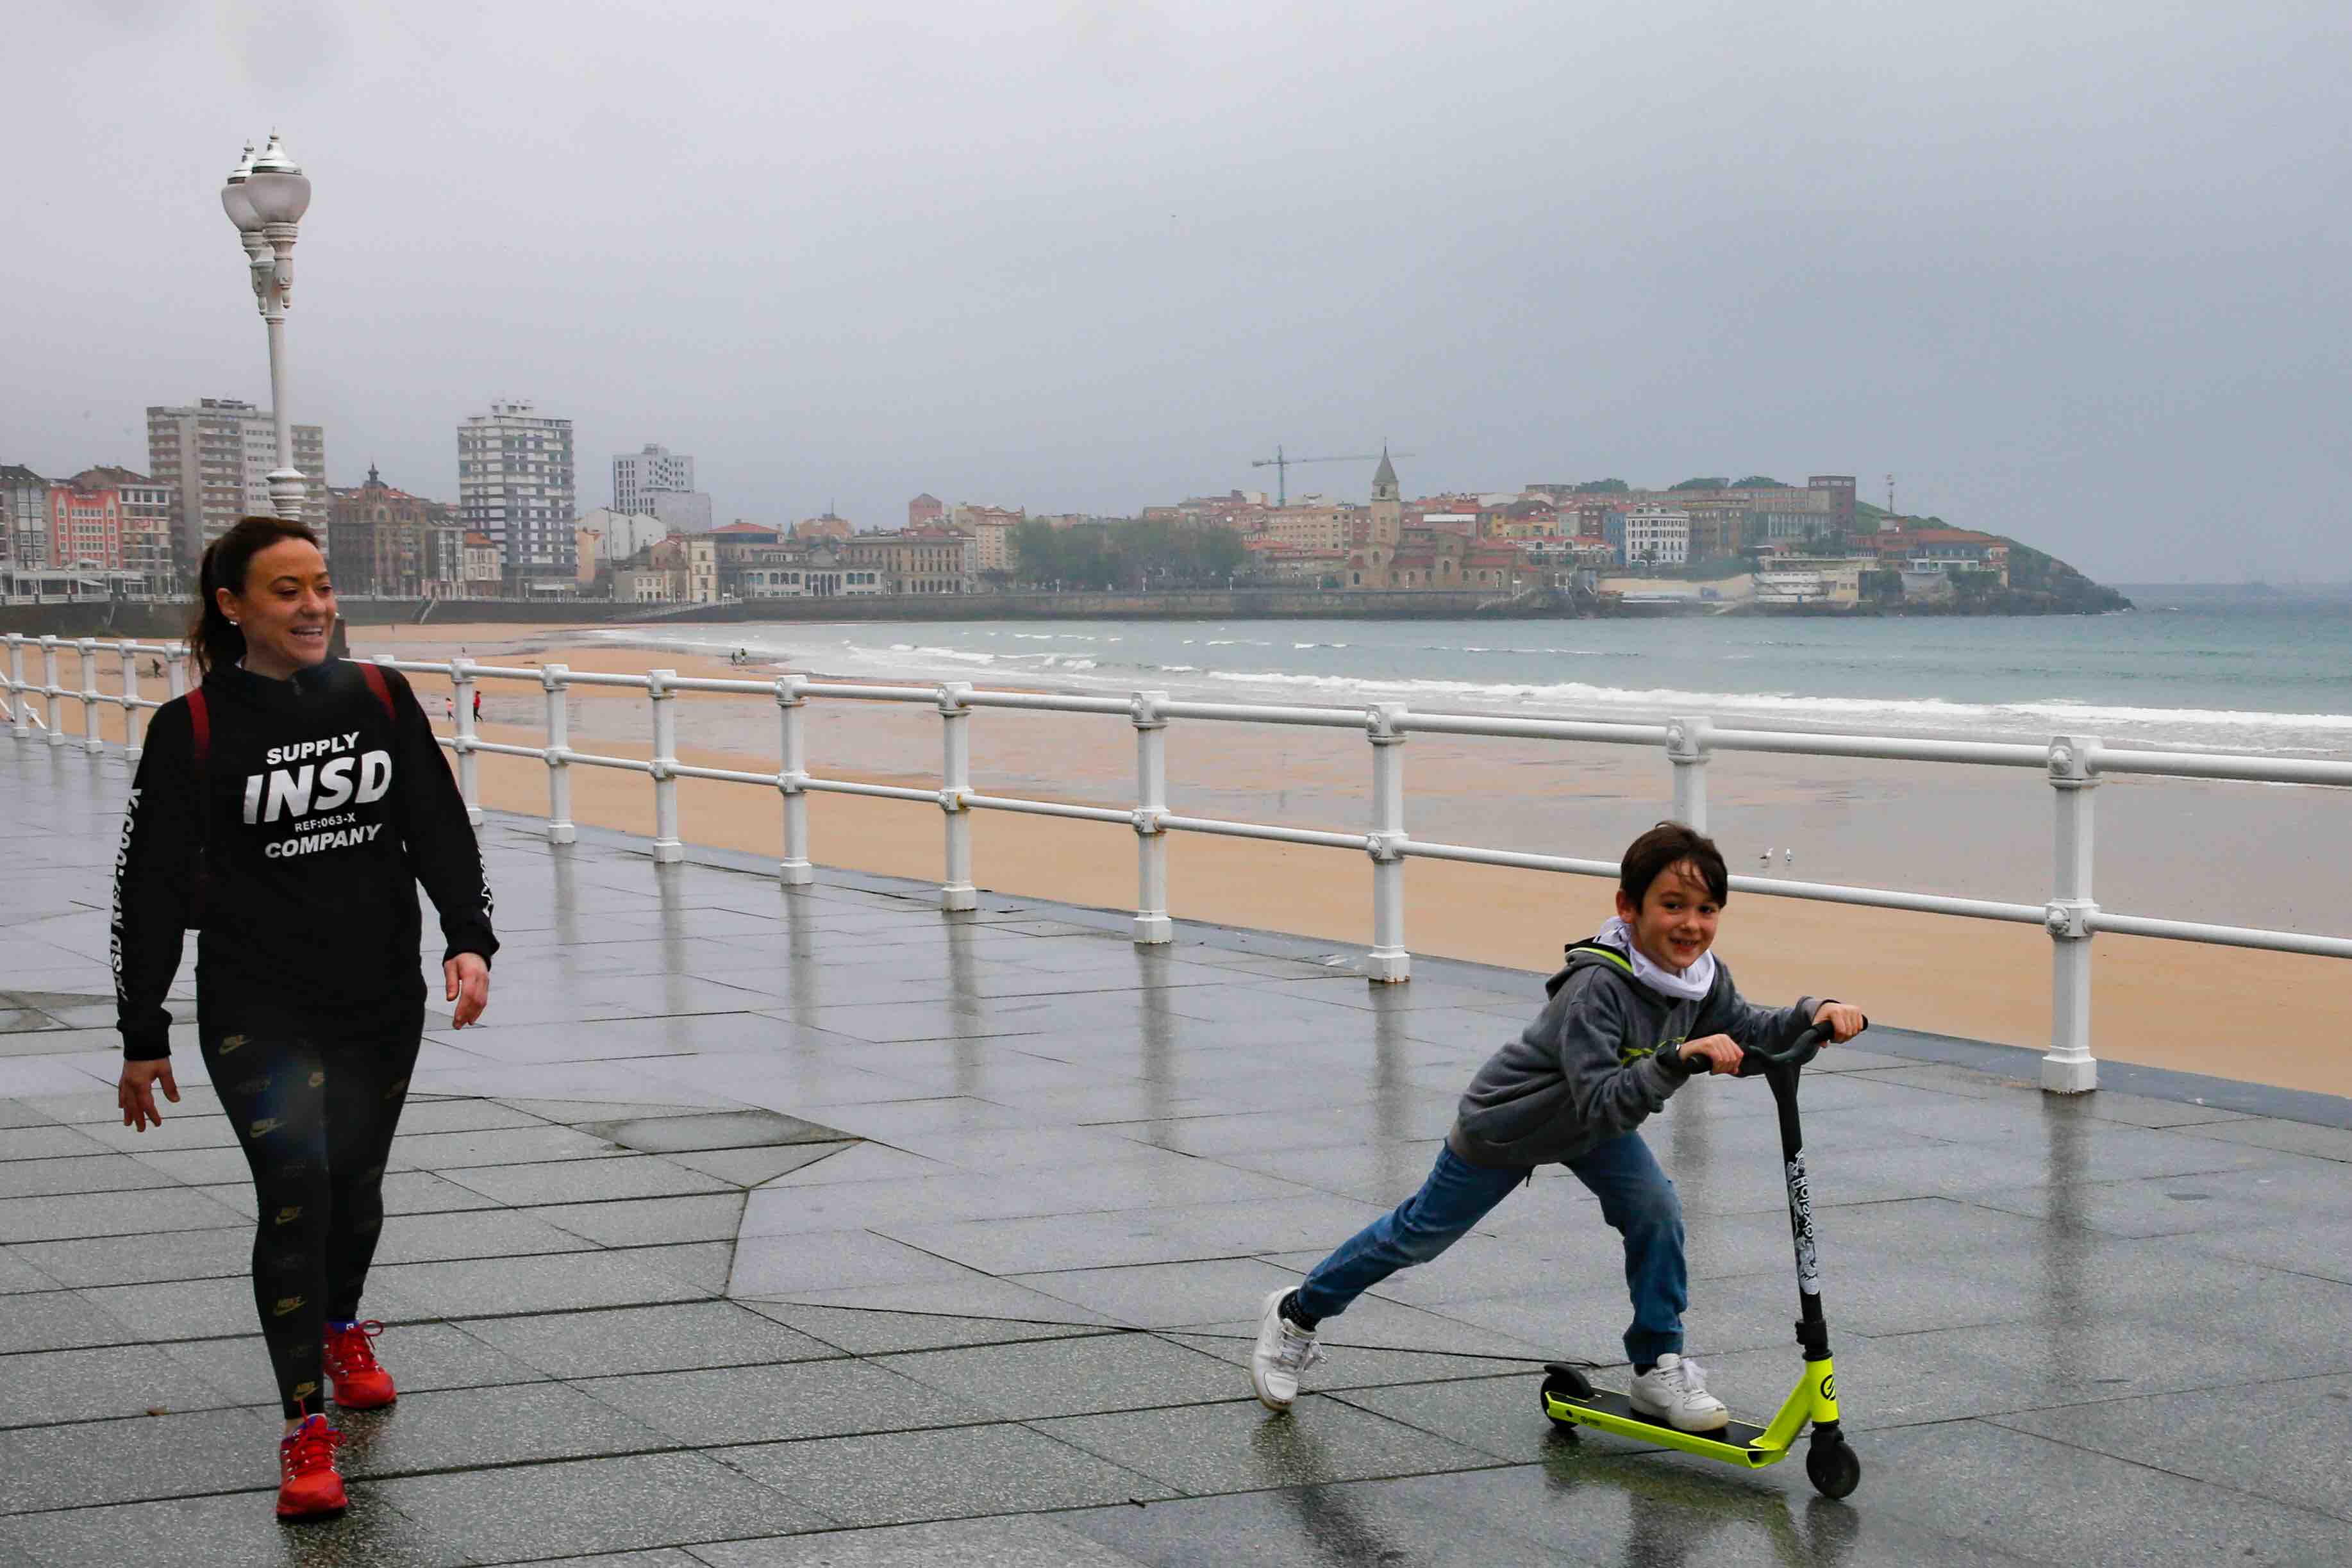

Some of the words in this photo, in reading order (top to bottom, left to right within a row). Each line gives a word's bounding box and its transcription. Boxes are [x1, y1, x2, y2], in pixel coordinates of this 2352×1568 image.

[266, 731, 360, 765] SUPPLY
[243, 749, 392, 824] INSD
[294, 812, 356, 833] REF:063-X
[264, 823, 383, 858] COMPANY
